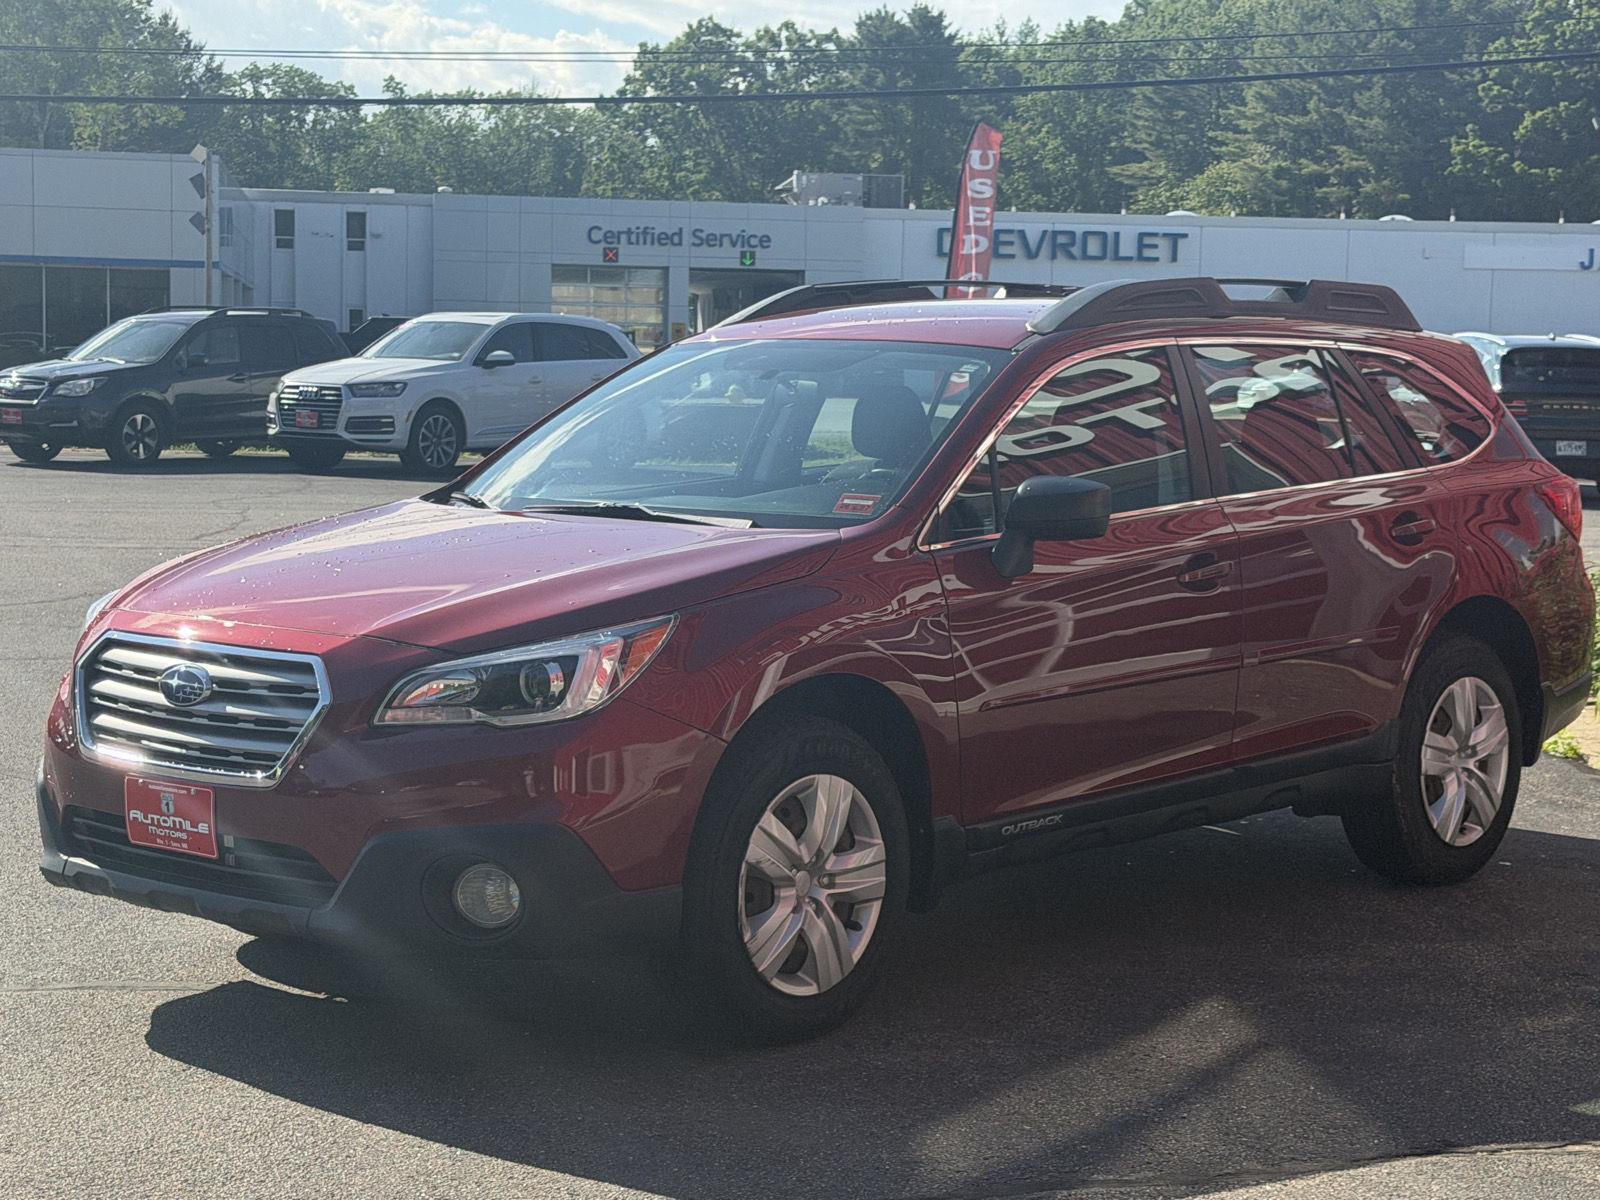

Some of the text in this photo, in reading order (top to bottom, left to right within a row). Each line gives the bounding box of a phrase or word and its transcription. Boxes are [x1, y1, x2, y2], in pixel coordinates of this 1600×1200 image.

[961, 150, 996, 255] USED
[587, 225, 772, 249] Certified Service
[936, 227, 1189, 263] CEVROLET
[1579, 248, 1600, 271] J
[129, 810, 209, 834] AUTOMILE
[148, 826, 188, 840] MOTORS
[1001, 814, 1063, 836] OUTBACK
